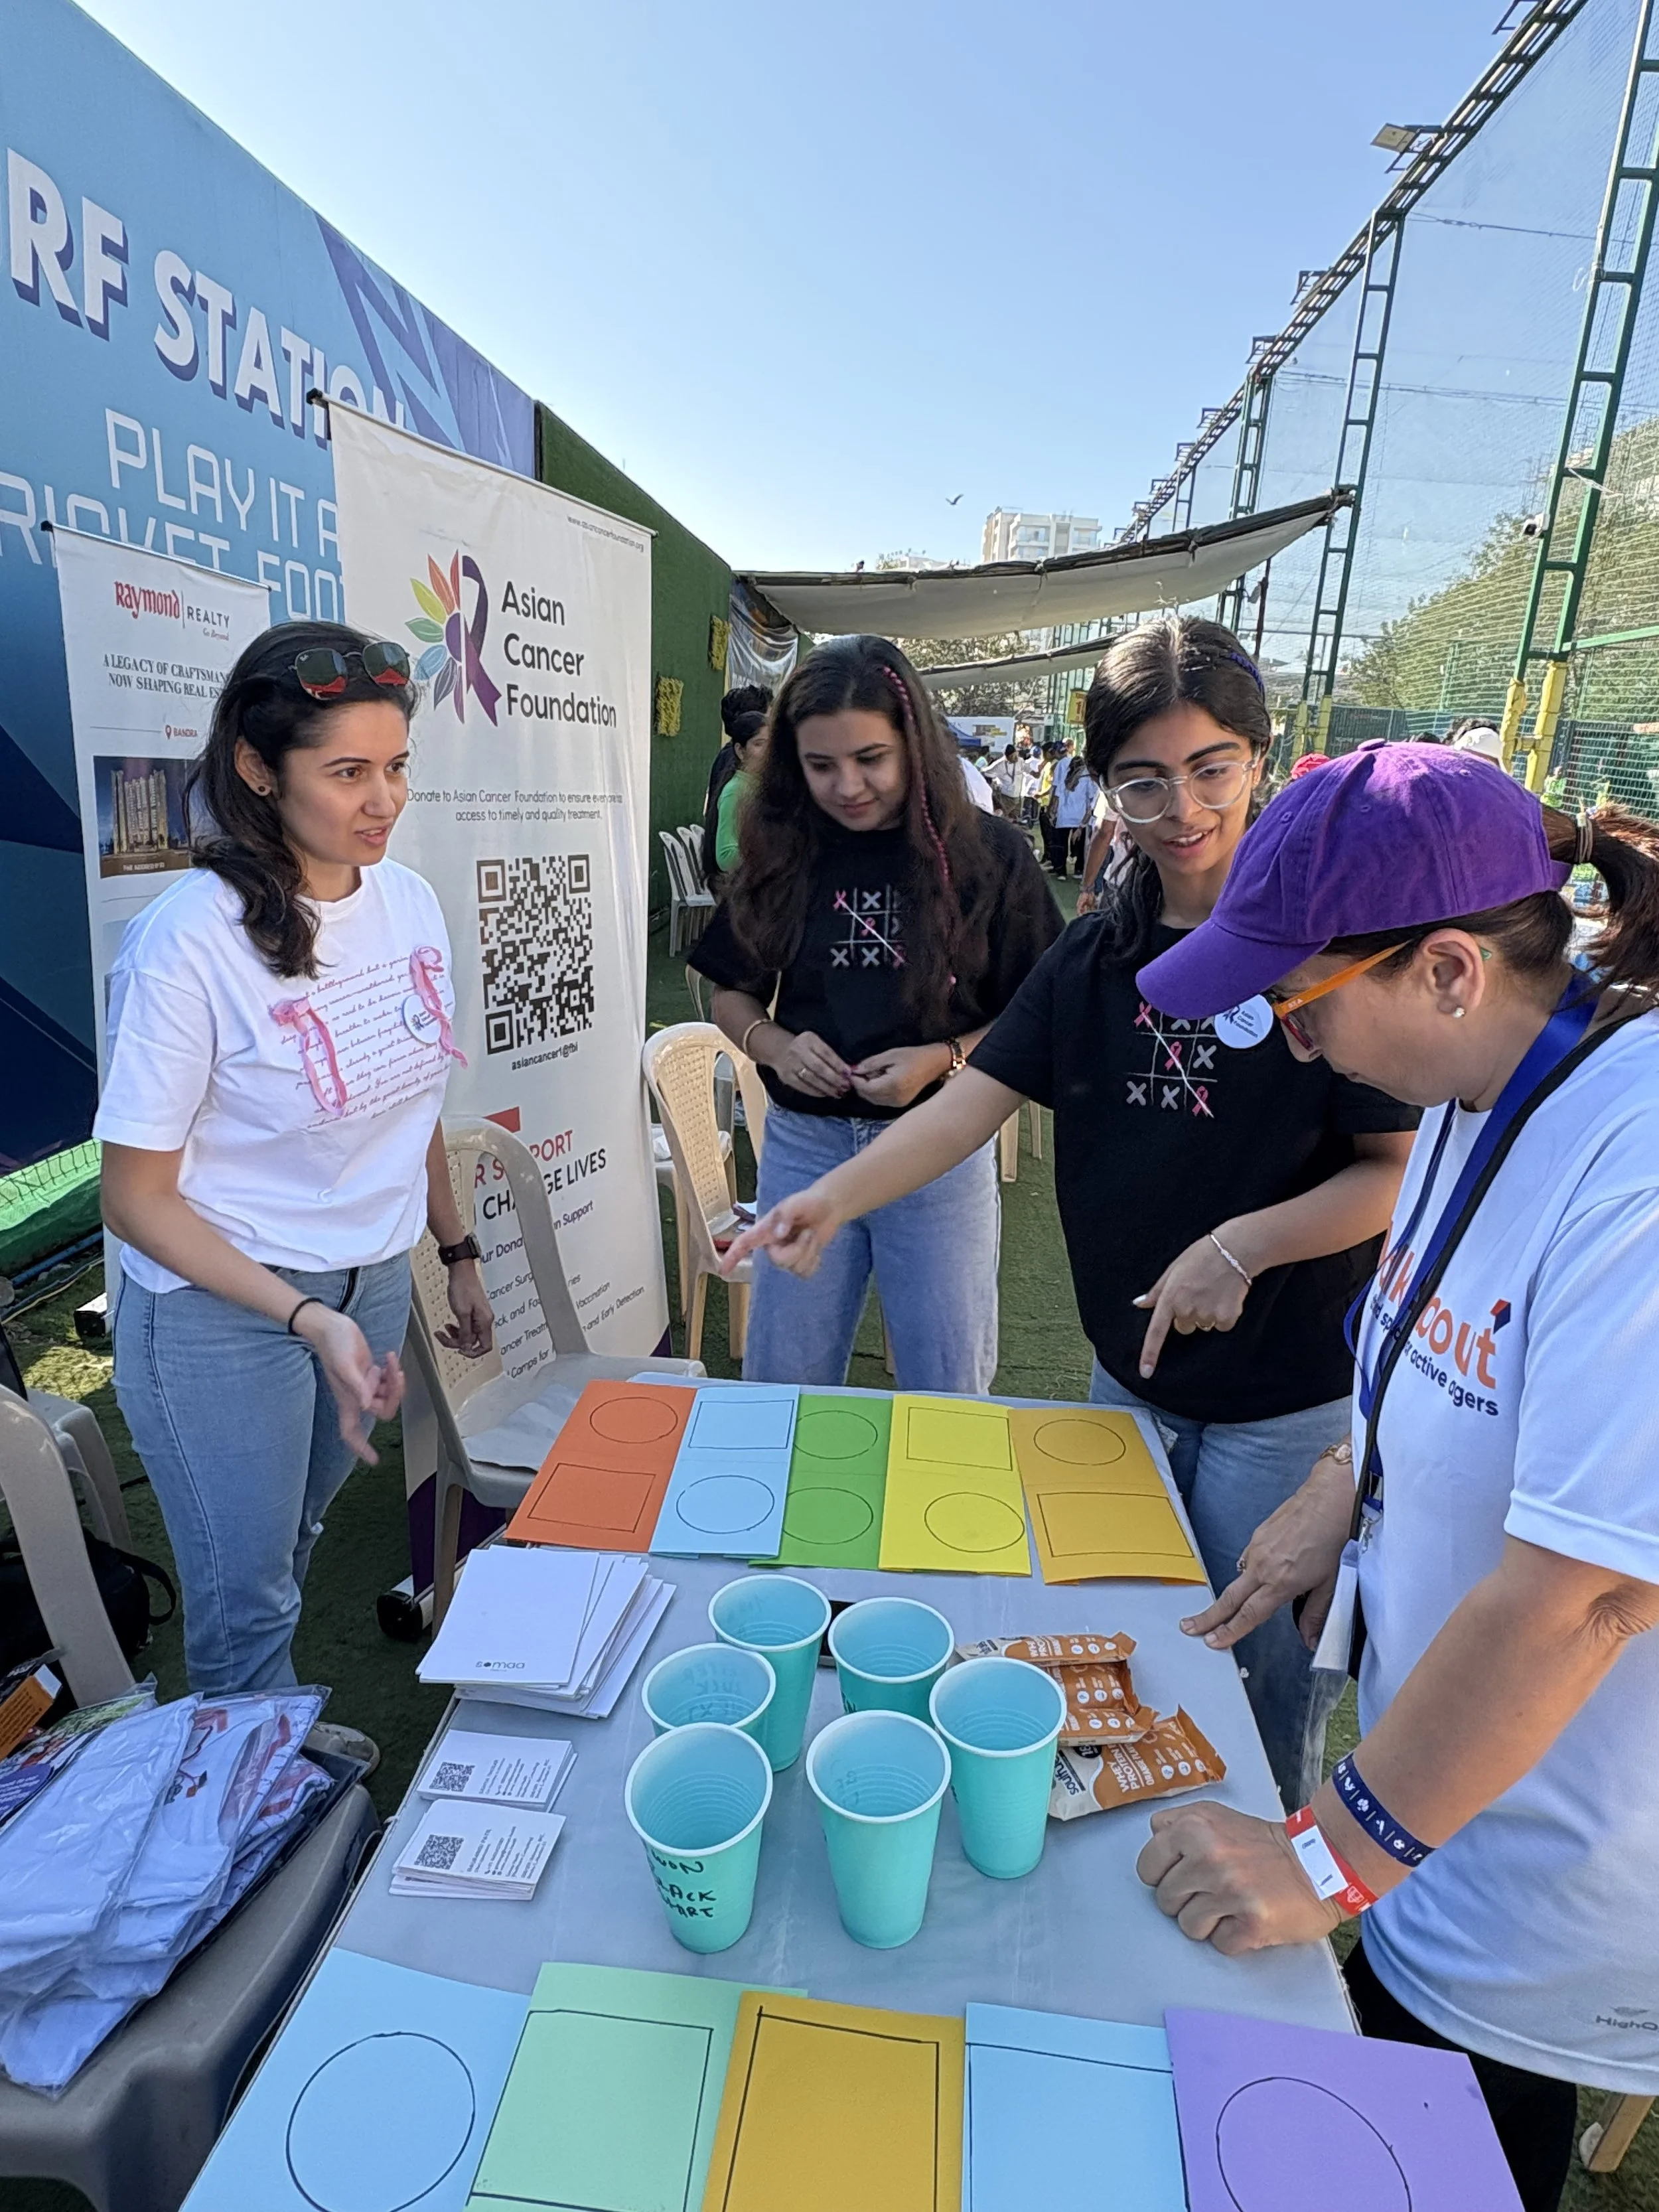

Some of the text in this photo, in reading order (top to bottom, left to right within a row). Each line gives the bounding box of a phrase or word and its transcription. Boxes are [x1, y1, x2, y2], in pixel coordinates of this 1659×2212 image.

[105, 408, 254, 531] PLAY
[269, 477, 305, 548] IT
[113, 580, 230, 628] Raymond REALTY
[501, 581, 565, 626] Asian
[103, 654, 229, 684] A LEGACY OF CRAFTSMAN
[504, 633, 585, 676] Cancer
[109, 672, 223, 700] NOW SHAPING REAL ES
[507, 684, 616, 728] Foundation
[408, 788, 441, 802] Donate
[443, 790, 452, 802] to
[453, 789, 477, 803] Asian
[479, 789, 511, 802] Cancer
[514, 790, 557, 803] Foundation
[559, 791, 566, 803] to
[456, 810, 486, 821] access
[488, 809, 497, 821] to
[499, 807, 524, 823] timely
[526, 808, 540, 820] and
[541, 808, 566, 822] quality
[567, 1148, 607, 1186] LIVES
[563, 1201, 593, 1226] Support
[510, 1303, 526, 1320] and
[500, 1334, 523, 1356] ancer
[1409, 1347, 1448, 1388] active
[1448, 1378, 1499, 1417] agers
[1106, 1760, 1129, 1793] WHEY
[1110, 1745, 1141, 1791] PROTEIN
